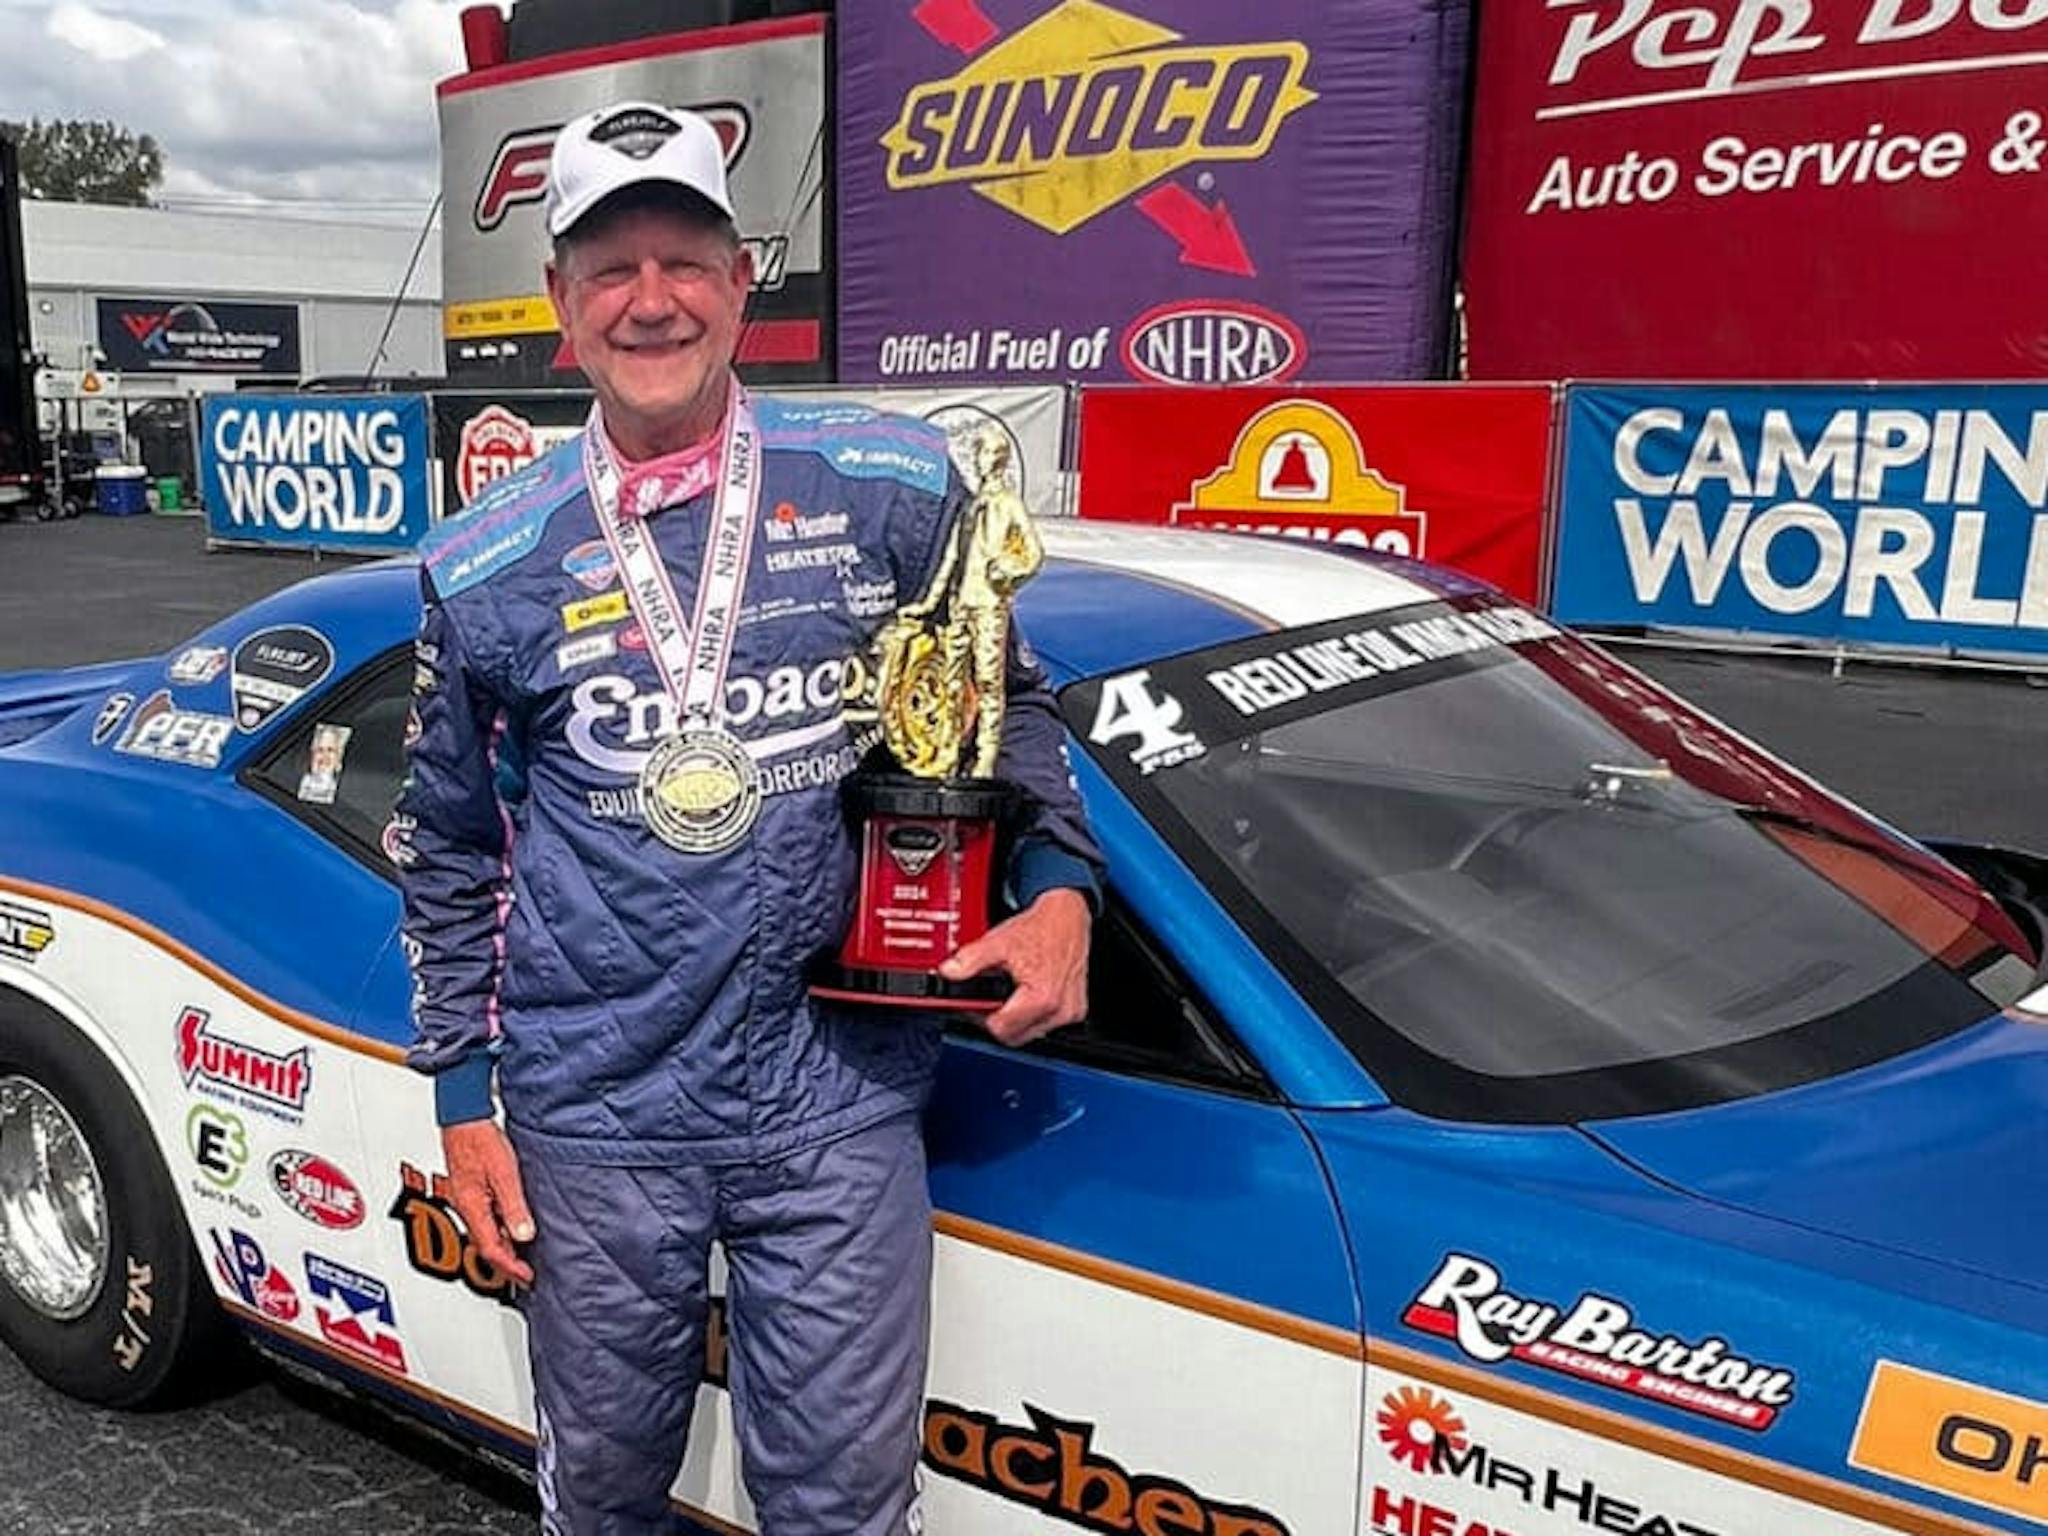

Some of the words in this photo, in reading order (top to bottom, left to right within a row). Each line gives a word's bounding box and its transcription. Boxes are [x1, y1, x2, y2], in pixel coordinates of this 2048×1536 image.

[897, 56, 1293, 174] SUNOCO
[1526, 156, 1679, 214] Auto
[1694, 123, 1968, 196] Service
[1987, 109, 2047, 174] &
[879, 331, 982, 375] Official
[988, 329, 1062, 371] Fuel
[1068, 326, 1111, 369] of
[1146, 316, 1280, 383] NHRA
[214, 409, 405, 468] CAMPING
[730, 431, 752, 489] NHRA
[217, 463, 404, 534] WORLD
[714, 514, 744, 578] NHRA
[638, 578, 675, 643] NHRA
[697, 607, 727, 672] NHRA
[1088, 669, 1197, 764] 4
[1205, 655, 1309, 718] RED
[180, 1013, 305, 1101] SUMMIT
[1416, 1252, 1561, 1363] Ray
[1549, 1293, 1795, 1404] Barton
